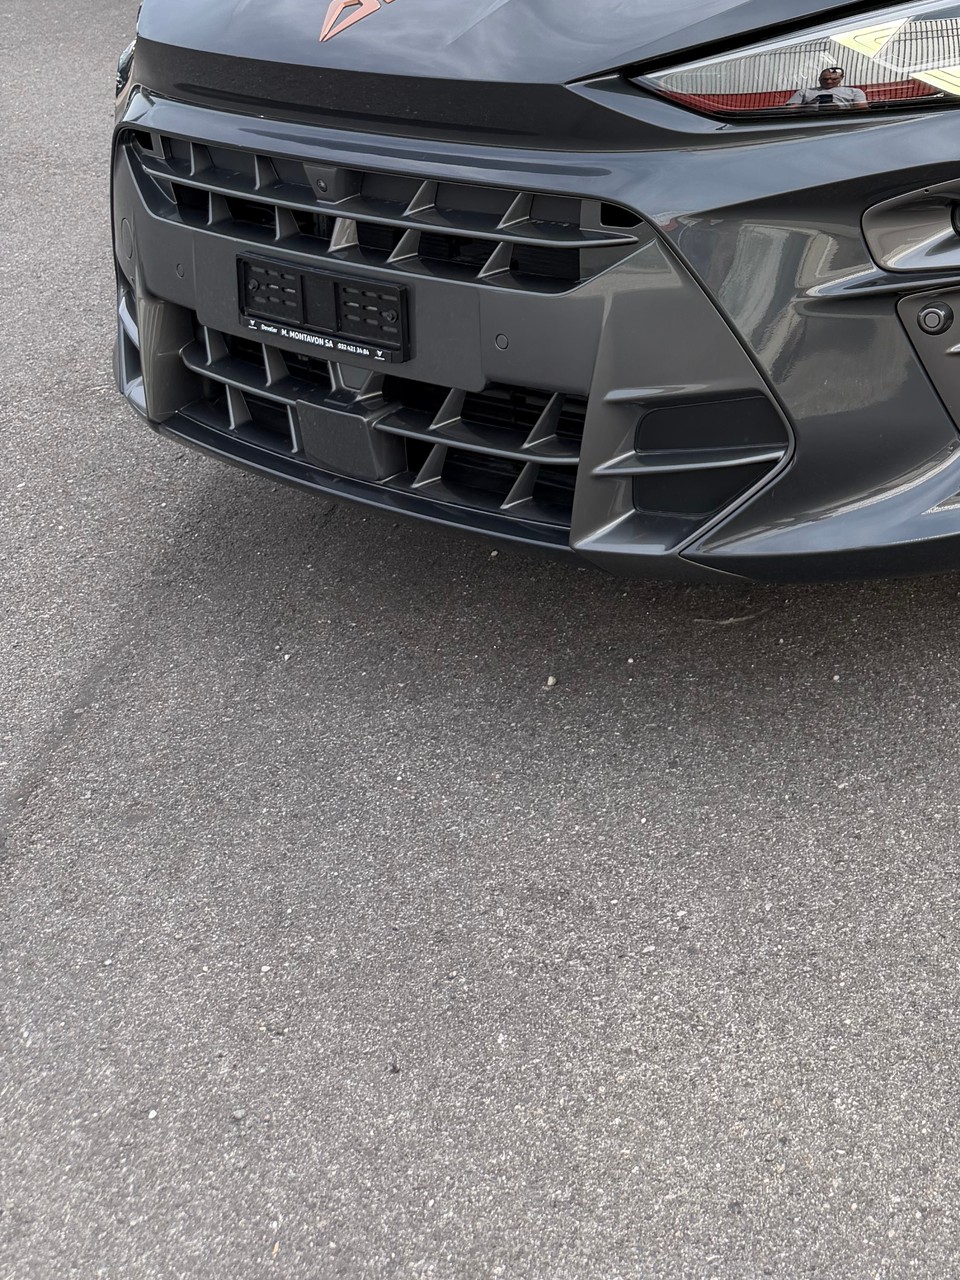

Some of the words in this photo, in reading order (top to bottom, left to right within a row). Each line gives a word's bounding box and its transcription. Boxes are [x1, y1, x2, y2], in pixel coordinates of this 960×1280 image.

[281, 328, 289, 337] M.
[289, 330, 324, 346] MONTAVON
[325, 339, 334, 348] SA
